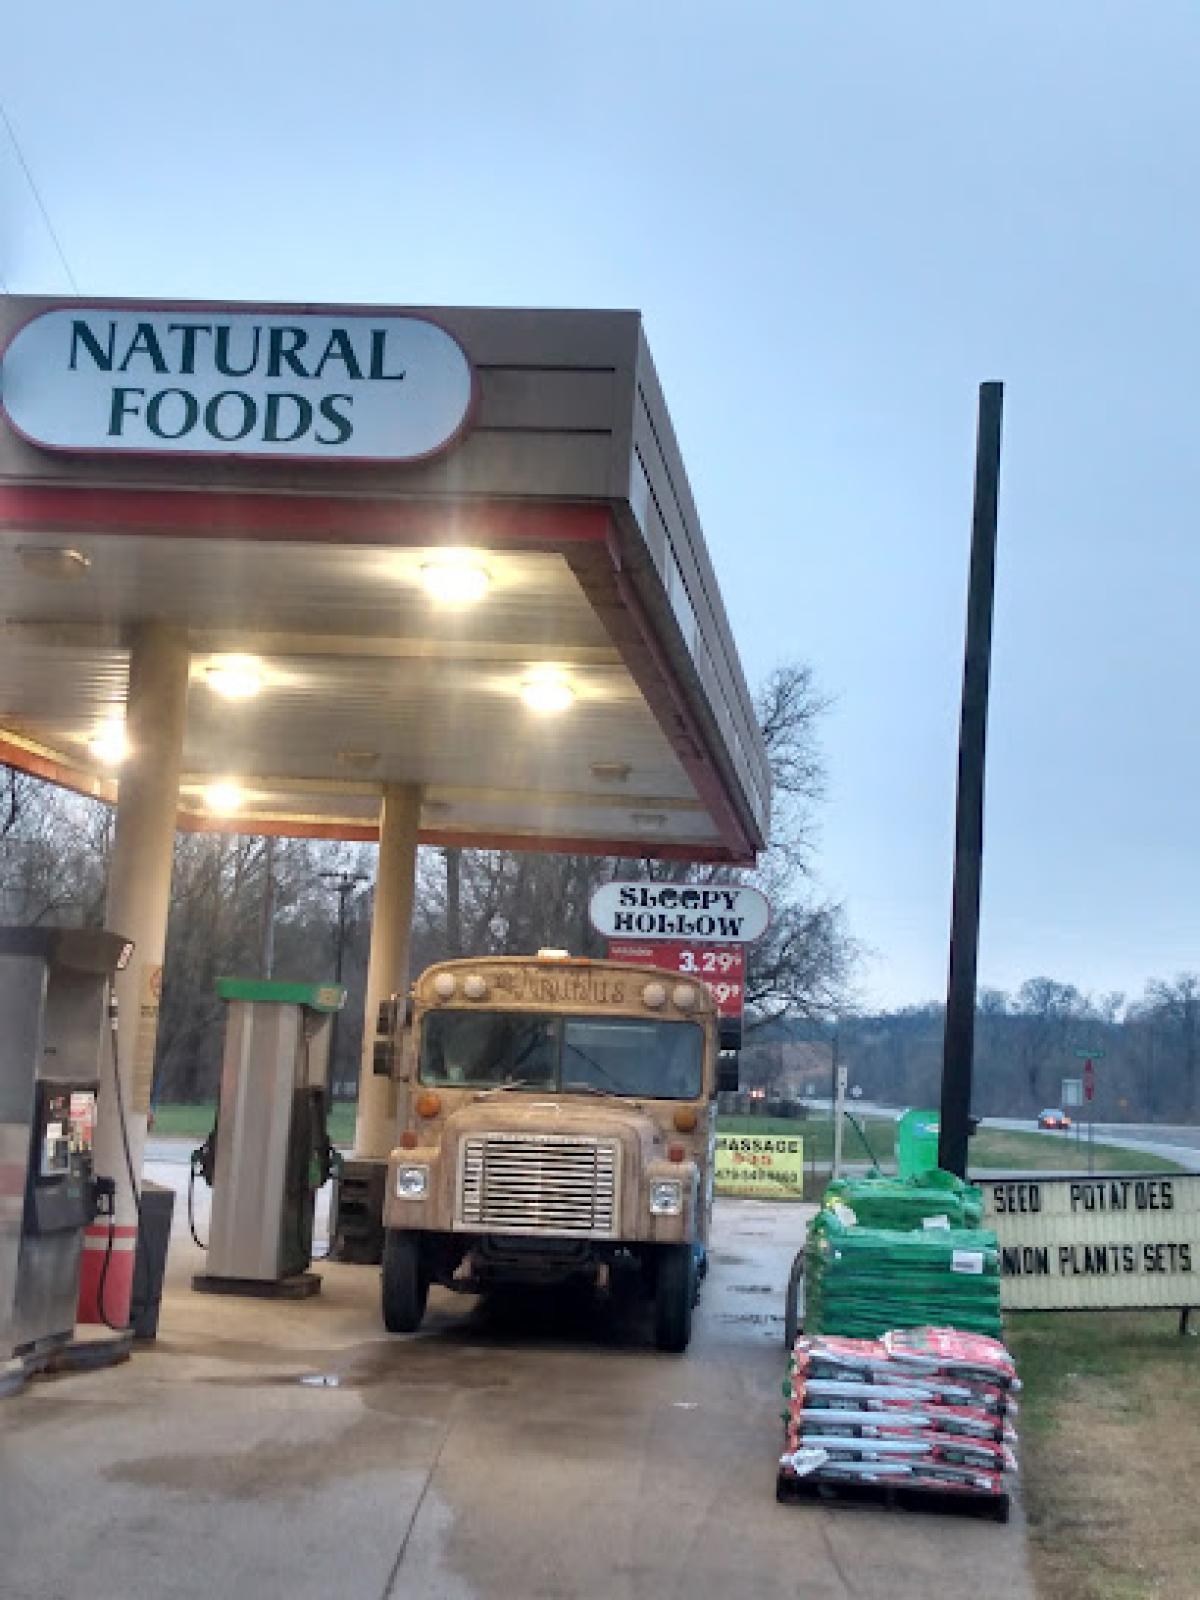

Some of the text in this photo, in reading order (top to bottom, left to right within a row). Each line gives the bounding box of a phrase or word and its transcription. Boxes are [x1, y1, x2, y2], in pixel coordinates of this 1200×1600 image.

[68, 320, 406, 381] NATURAL
[107, 387, 354, 445] FOODS
[618, 886, 742, 911] SLEEPY
[614, 911, 745, 936] HOLLOW
[993, 1181, 1174, 1213] SEED POTATOES
[1001, 1243, 1192, 1276] NION PLANTS SETS
